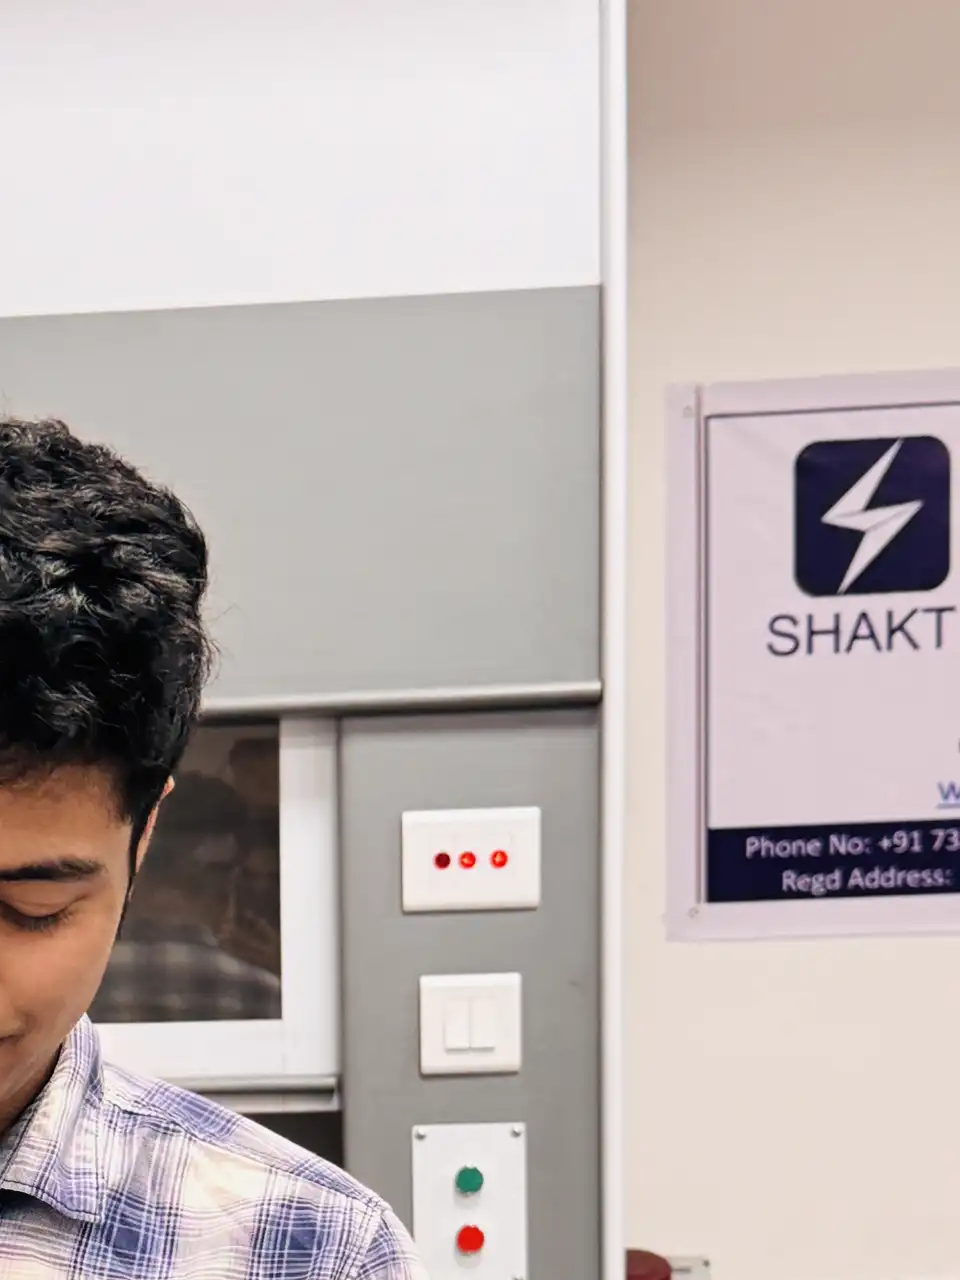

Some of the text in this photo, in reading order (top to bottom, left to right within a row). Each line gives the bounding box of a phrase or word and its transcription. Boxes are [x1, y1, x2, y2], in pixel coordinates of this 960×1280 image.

[767, 606, 956, 656] SHAKT
[745, 835, 823, 859] Phone
[829, 833, 872, 855] No:
[878, 830, 924, 854] +91
[781, 866, 953, 896] Regd Address:
